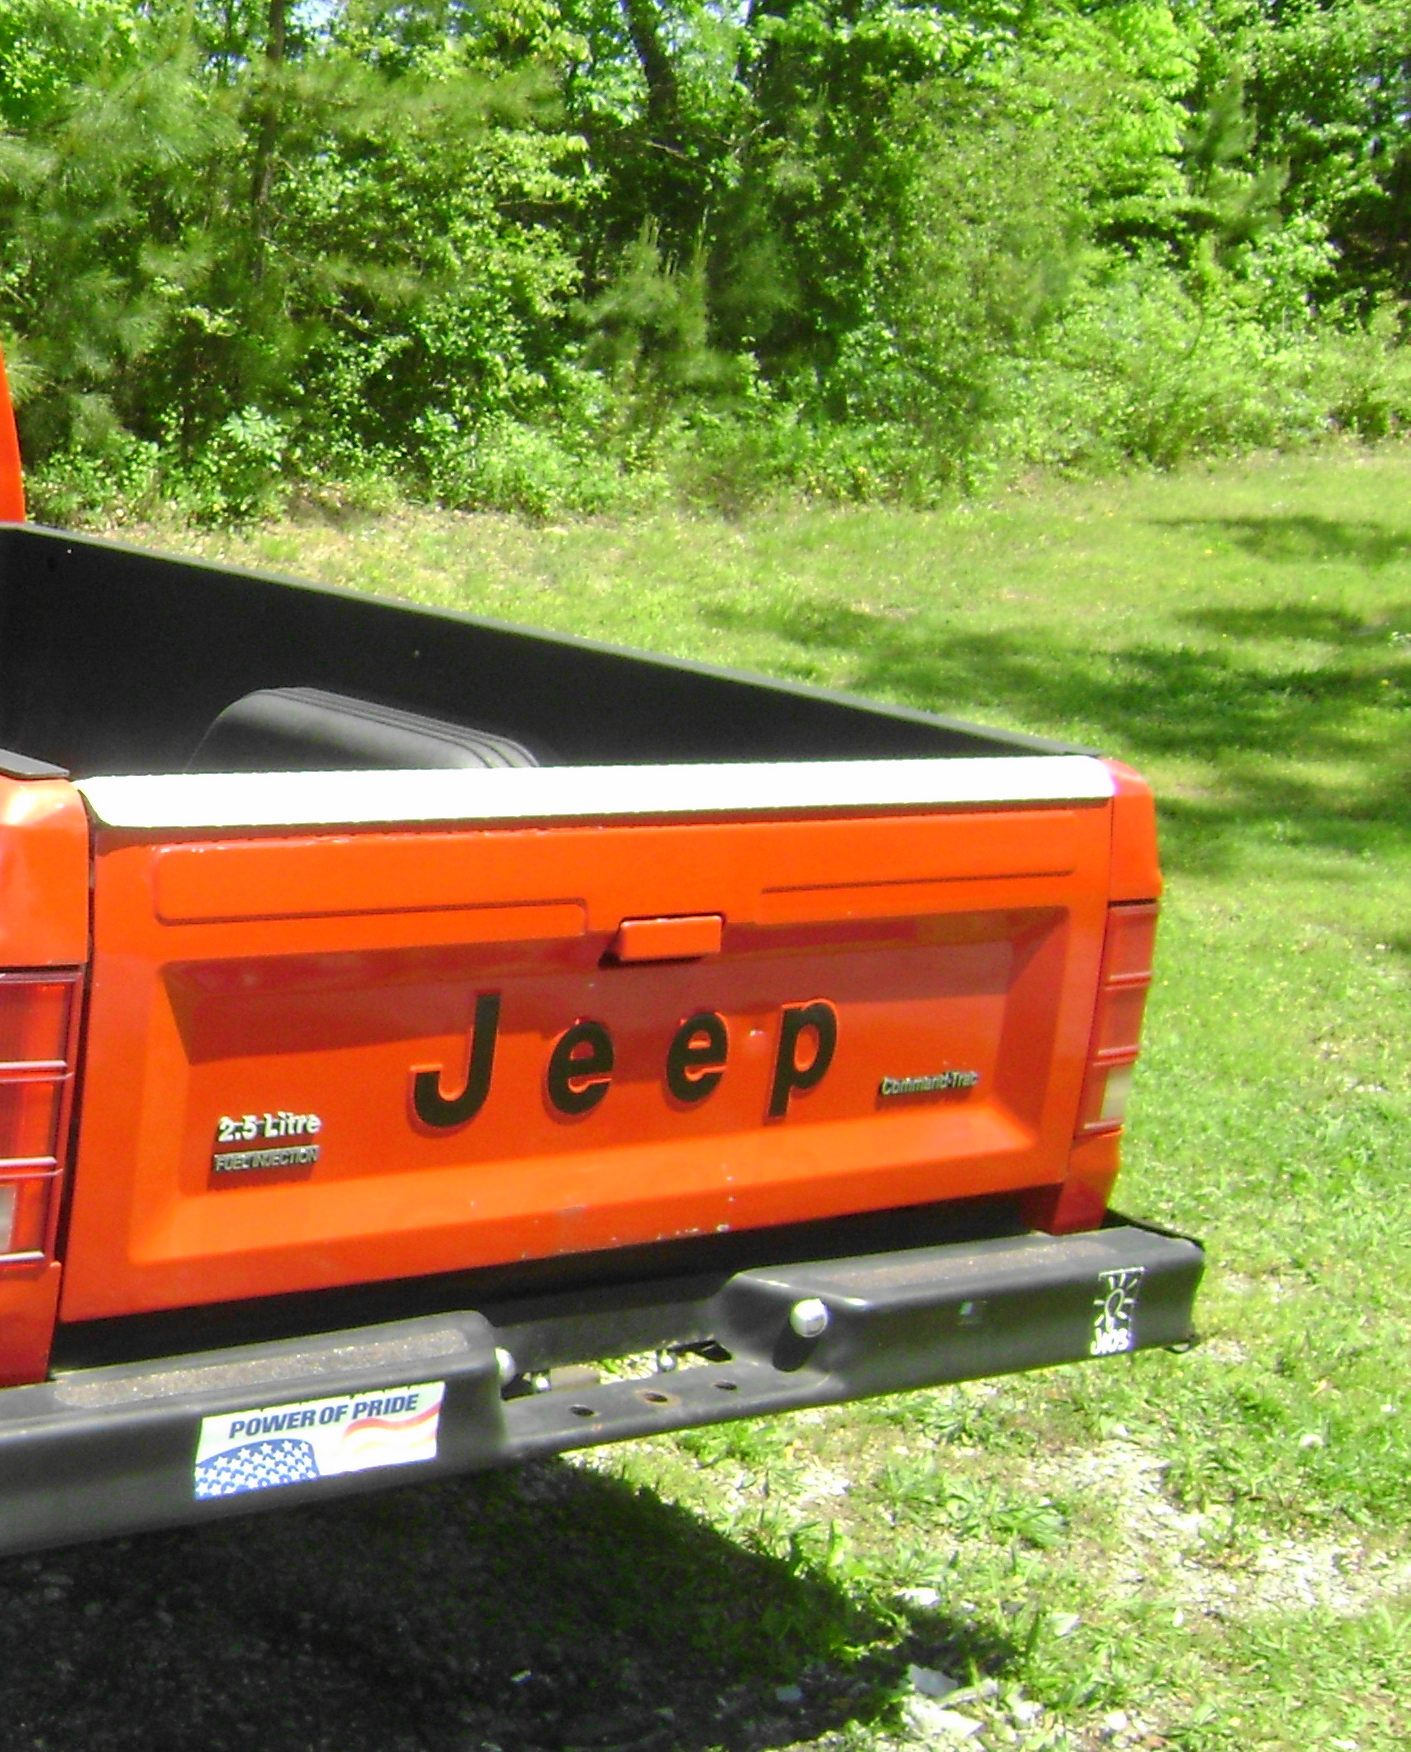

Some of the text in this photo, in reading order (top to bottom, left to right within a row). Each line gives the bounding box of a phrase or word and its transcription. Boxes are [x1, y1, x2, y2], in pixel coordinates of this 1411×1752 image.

[411, 993, 838, 1128] Jeep
[217, 1111, 322, 1142] 2.5 Litre
[215, 1147, 319, 1172] FUEL INJECTION
[228, 1393, 420, 1439] POWER OF PRIDE
